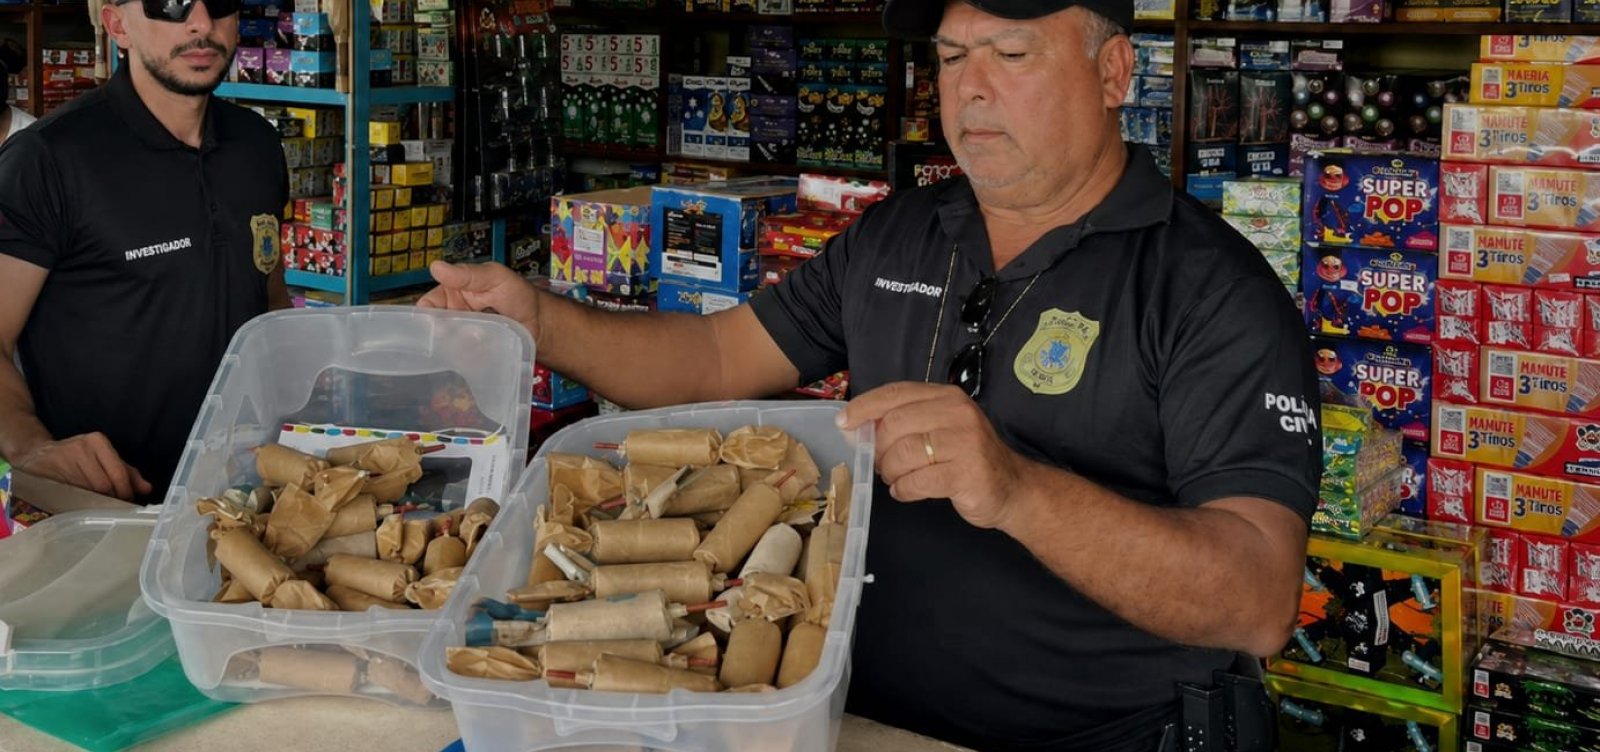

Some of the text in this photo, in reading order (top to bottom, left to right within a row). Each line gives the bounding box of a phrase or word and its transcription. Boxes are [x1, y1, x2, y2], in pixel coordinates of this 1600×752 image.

[562, 36, 570, 51] 5
[585, 36, 594, 51] 5
[610, 36, 618, 52] 5
[634, 37, 642, 53] 5
[562, 55, 570, 71] 5
[585, 56, 593, 71] 5
[610, 56, 618, 72] 5
[635, 58, 643, 73] 5
[1505, 81, 1550, 98] 3 Tiros
[1479, 129, 1527, 147] 3 Tiros
[1363, 178, 1428, 198] SUPER
[1366, 195, 1424, 222] POP
[1527, 192, 1577, 211] 3 Tiros
[125, 237, 192, 261] INVESTIGADOR
[1477, 236, 1525, 251] MAMUTE
[1476, 250, 1525, 268] 3 Tiros
[1361, 270, 1426, 292] SUPER
[1364, 289, 1421, 315] POP
[1356, 364, 1420, 388] SUPER
[1521, 361, 1568, 379] MAMUTE
[1519, 375, 1568, 395] 3 Tiros
[1360, 381, 1417, 411] POP
[1469, 417, 1515, 434] MAMUTE
[1467, 430, 1480, 449] 3
[1516, 484, 1563, 502] MAMUTE
[1514, 498, 1563, 517] 3 Tiros
